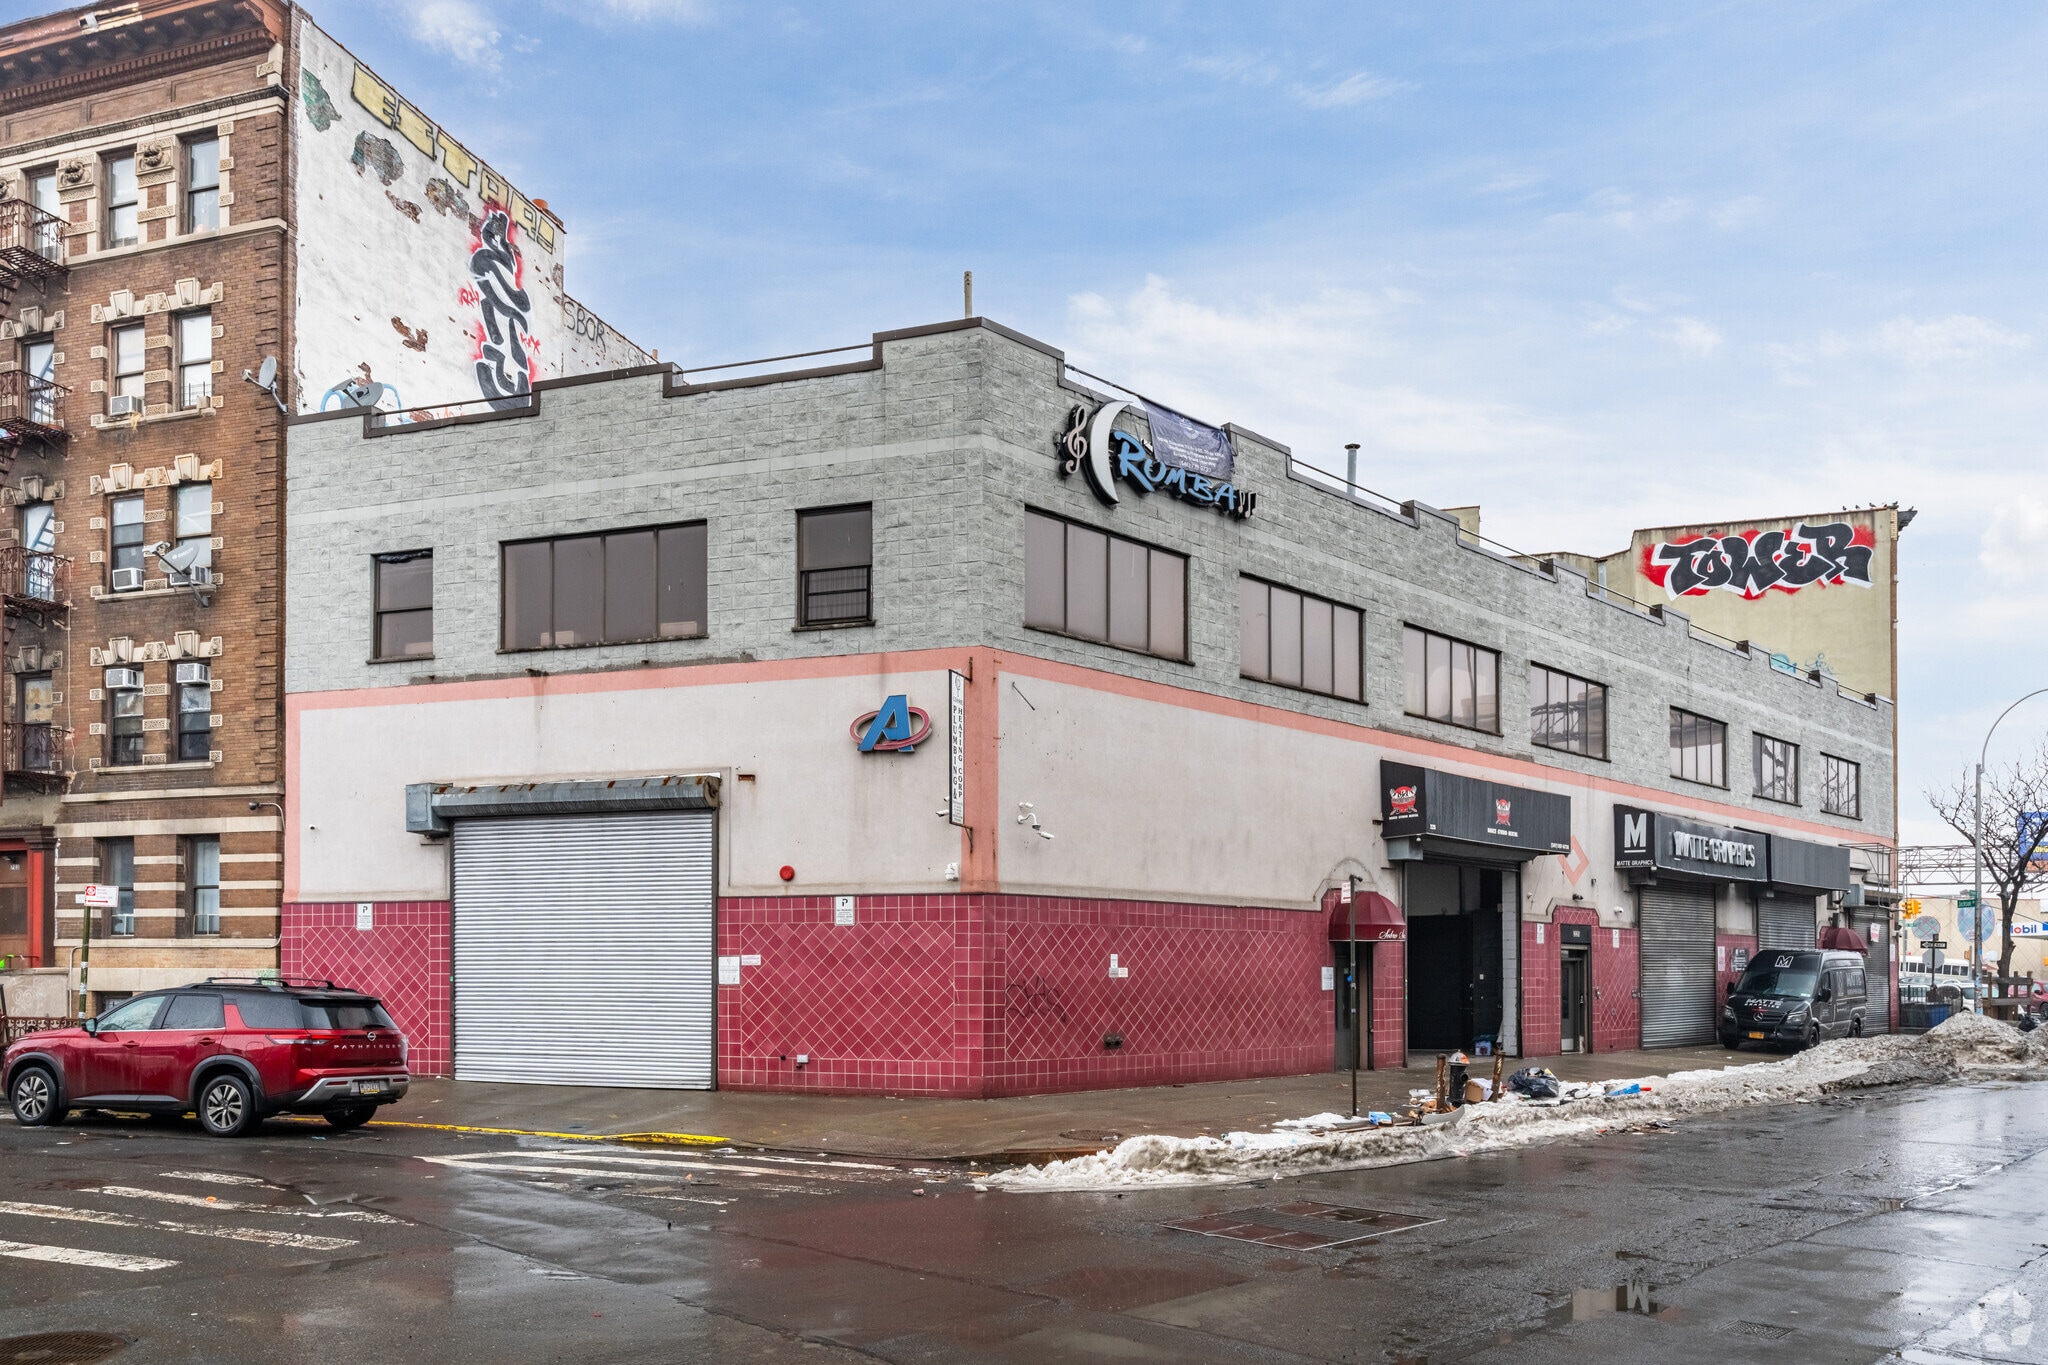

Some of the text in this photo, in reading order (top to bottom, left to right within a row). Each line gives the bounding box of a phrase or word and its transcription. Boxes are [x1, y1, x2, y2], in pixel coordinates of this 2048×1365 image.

[1113, 430, 1237, 510] RUMBA
[1651, 522, 1875, 601] TOWER
[1624, 813, 1647, 848] M
[1709, 838, 1756, 868] GRAPHICS
[1774, 955, 1795, 969] M
